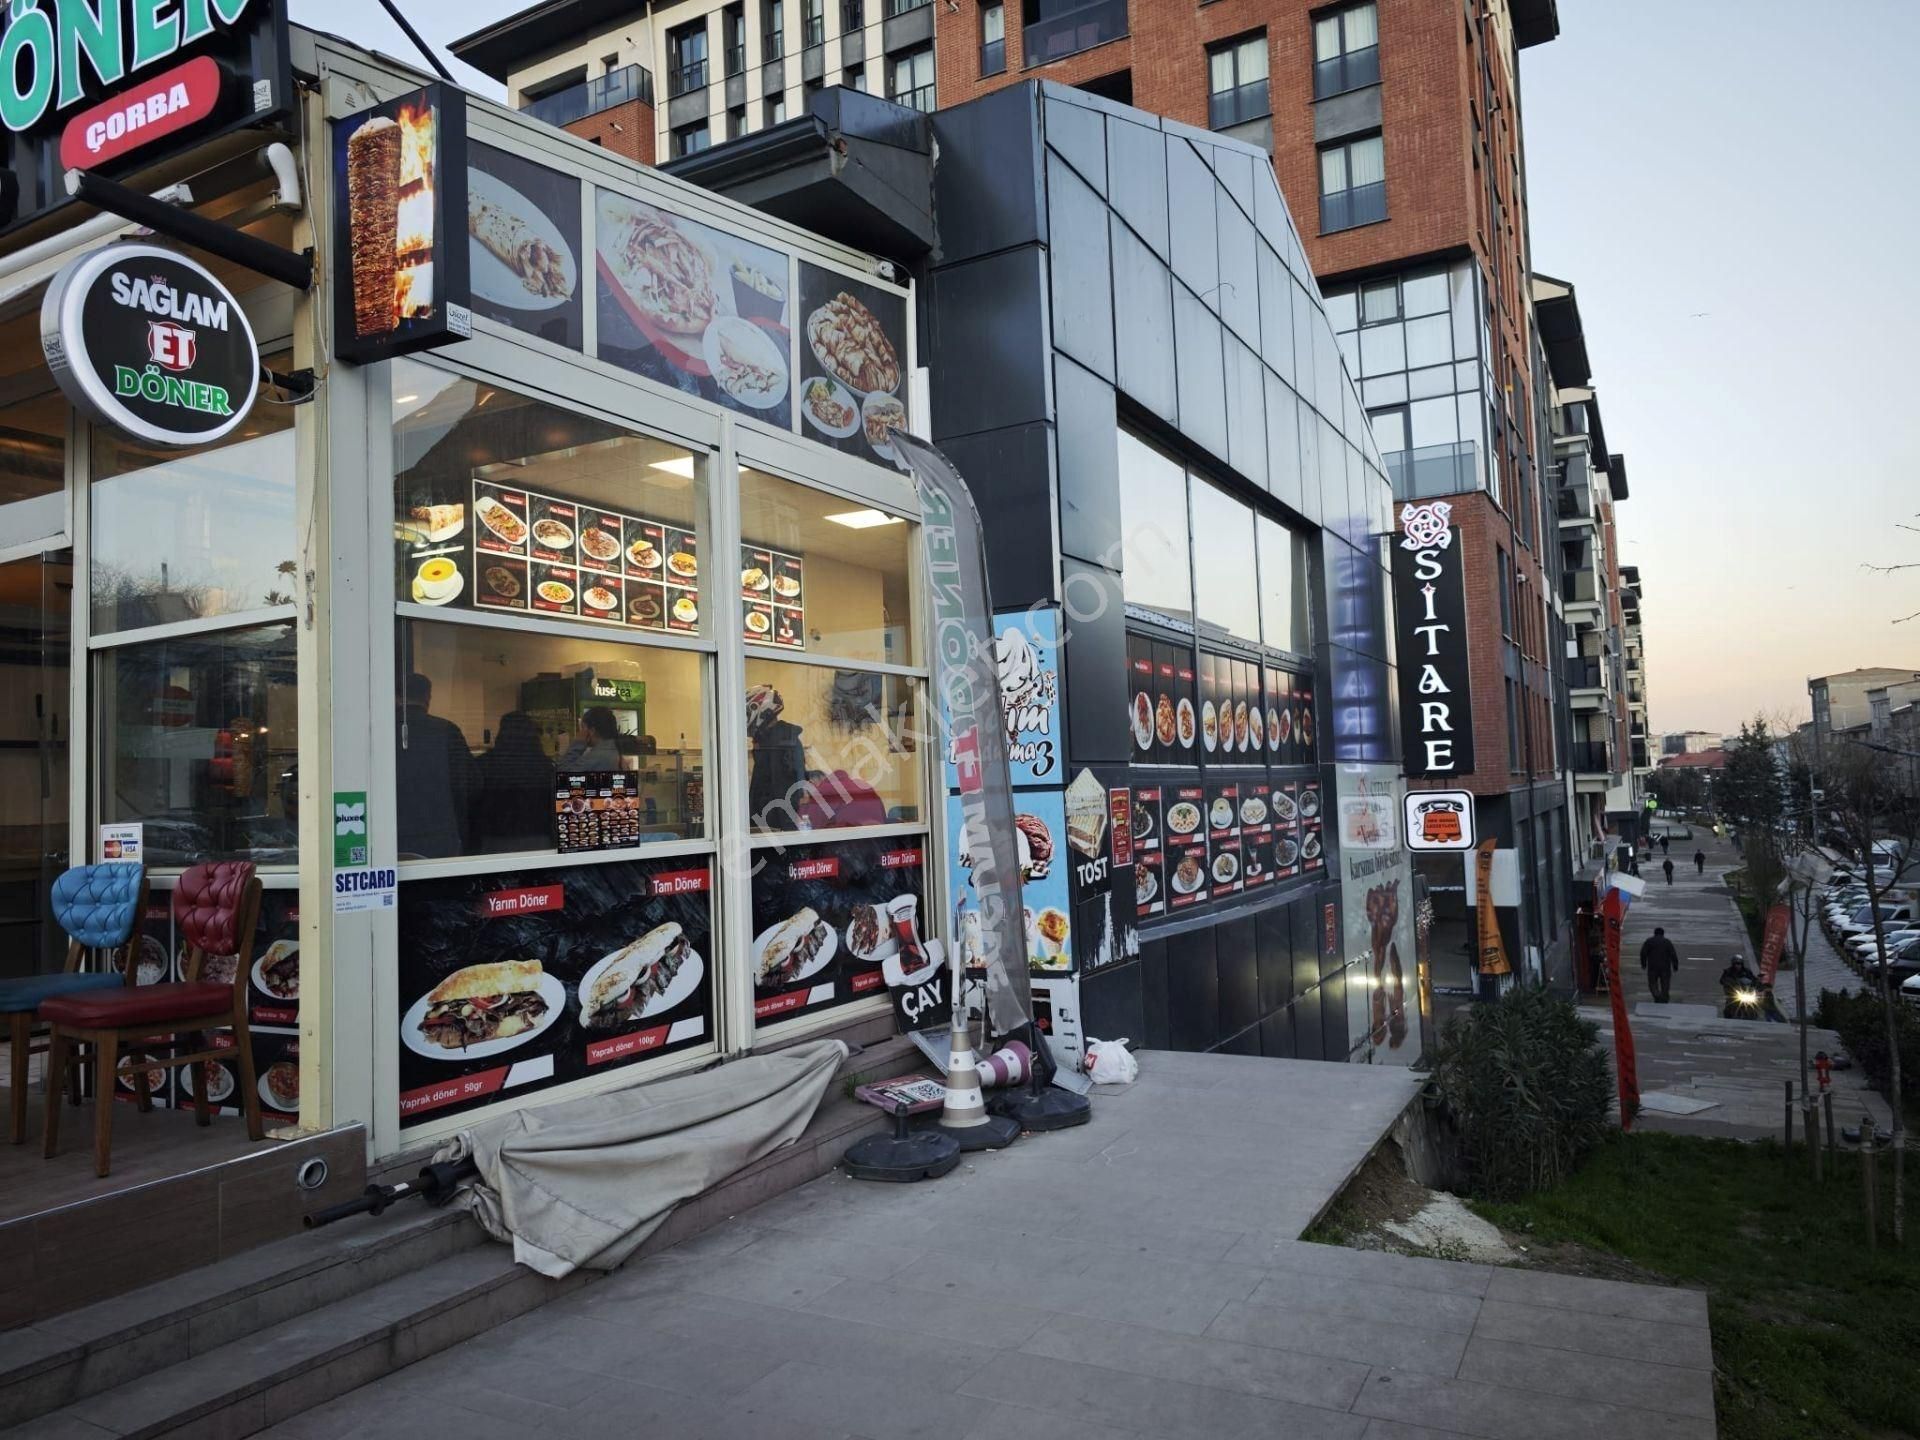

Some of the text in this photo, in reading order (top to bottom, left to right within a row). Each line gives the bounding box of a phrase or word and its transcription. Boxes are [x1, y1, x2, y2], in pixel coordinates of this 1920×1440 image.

[85, 82, 191, 153] ÇORBA
[151, 323, 195, 367] ET
[114, 364, 235, 417] DÖNER
[816, 862, 834, 875] Döner
[887, 854, 901, 866] Döner
[1076, 856, 1109, 888] TOST
[335, 869, 396, 893] SETCARD
[653, 876, 703, 895] Tam Döner
[489, 893, 549, 913] Yarım Döner
[901, 979, 944, 1024] ÇAY
[591, 1034, 657, 1059] Yaprak döner 100gr
[400, 1080, 484, 1111] Yaprak döner 50gr
